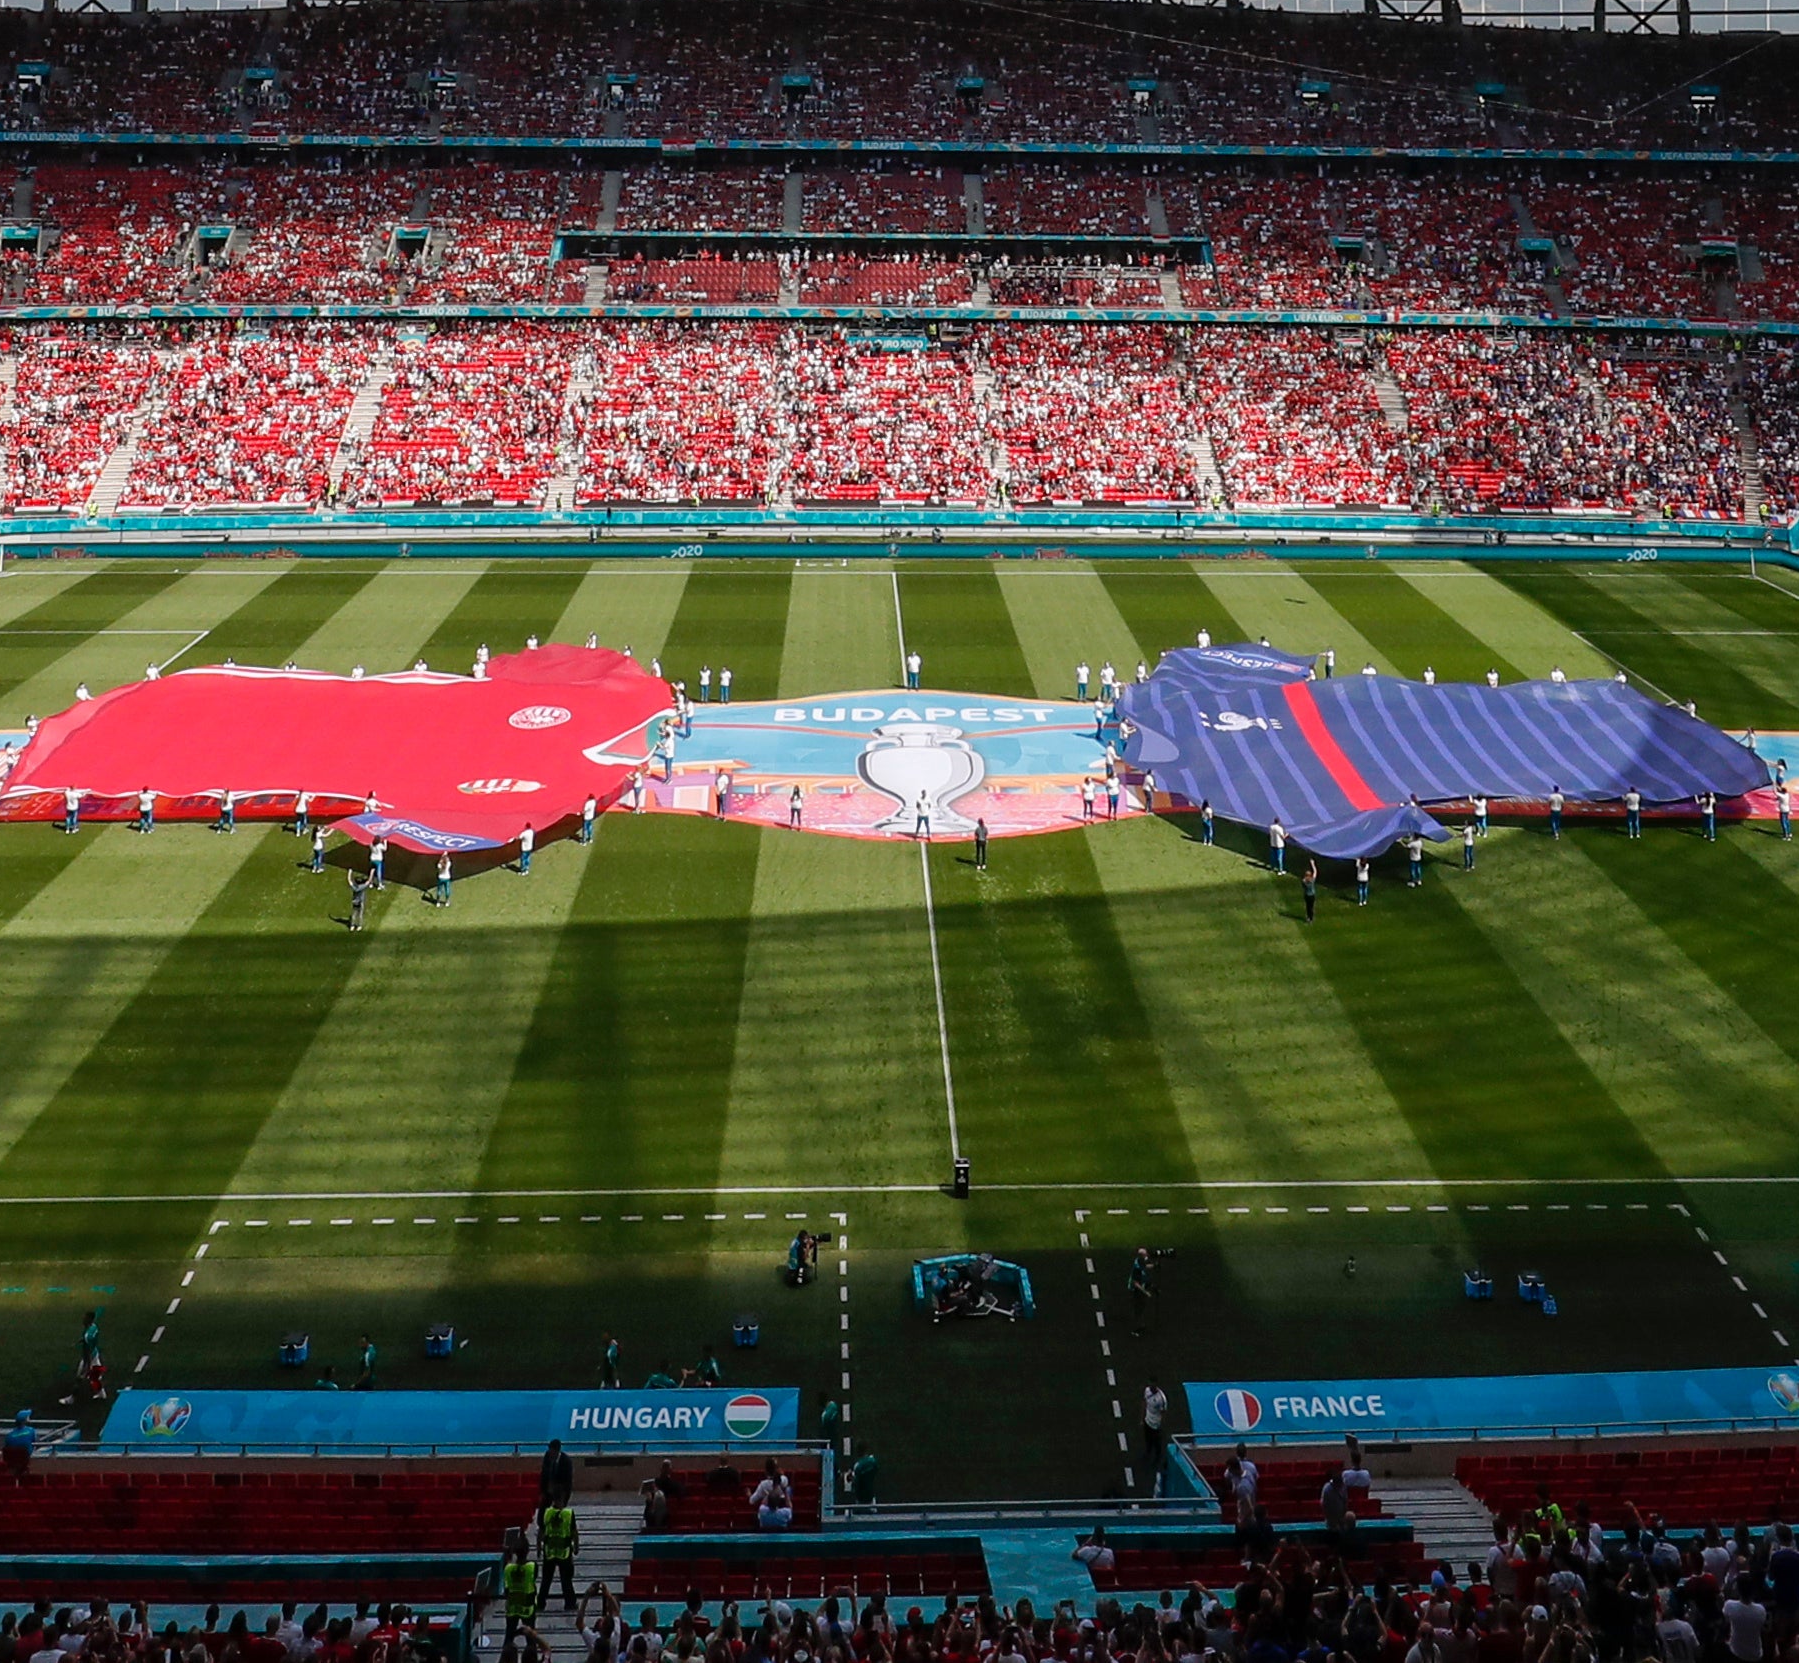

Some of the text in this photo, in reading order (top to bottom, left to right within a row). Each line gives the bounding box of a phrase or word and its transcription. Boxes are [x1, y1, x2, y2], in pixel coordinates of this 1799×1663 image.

[3, 132, 79, 142] UEFA EURO 2020
[312, 136, 359, 144] BUDAPEST
[580, 138, 647, 147] UEFA EURO 2020
[861, 141, 905, 150] BUDAPEST
[1139, 144, 1161, 153] EURO
[1161, 145, 1182, 153] 2020
[1685, 151, 1707, 160] EURO
[1708, 152, 1732, 161] 2020
[444, 307, 469, 316] 2020
[700, 308, 749, 316] BUDAPEST
[1019, 310, 1067, 319] BUDAPEST
[1293, 313, 1316, 322] UEFA
[899, 339, 923, 349] 2020
[773, 707, 1055, 722] BUDAPEST
[399, 822, 477, 849] RESPECT
[1273, 1394, 1386, 1418] FRANCE
[569, 1406, 711, 1429] HUNGARY
